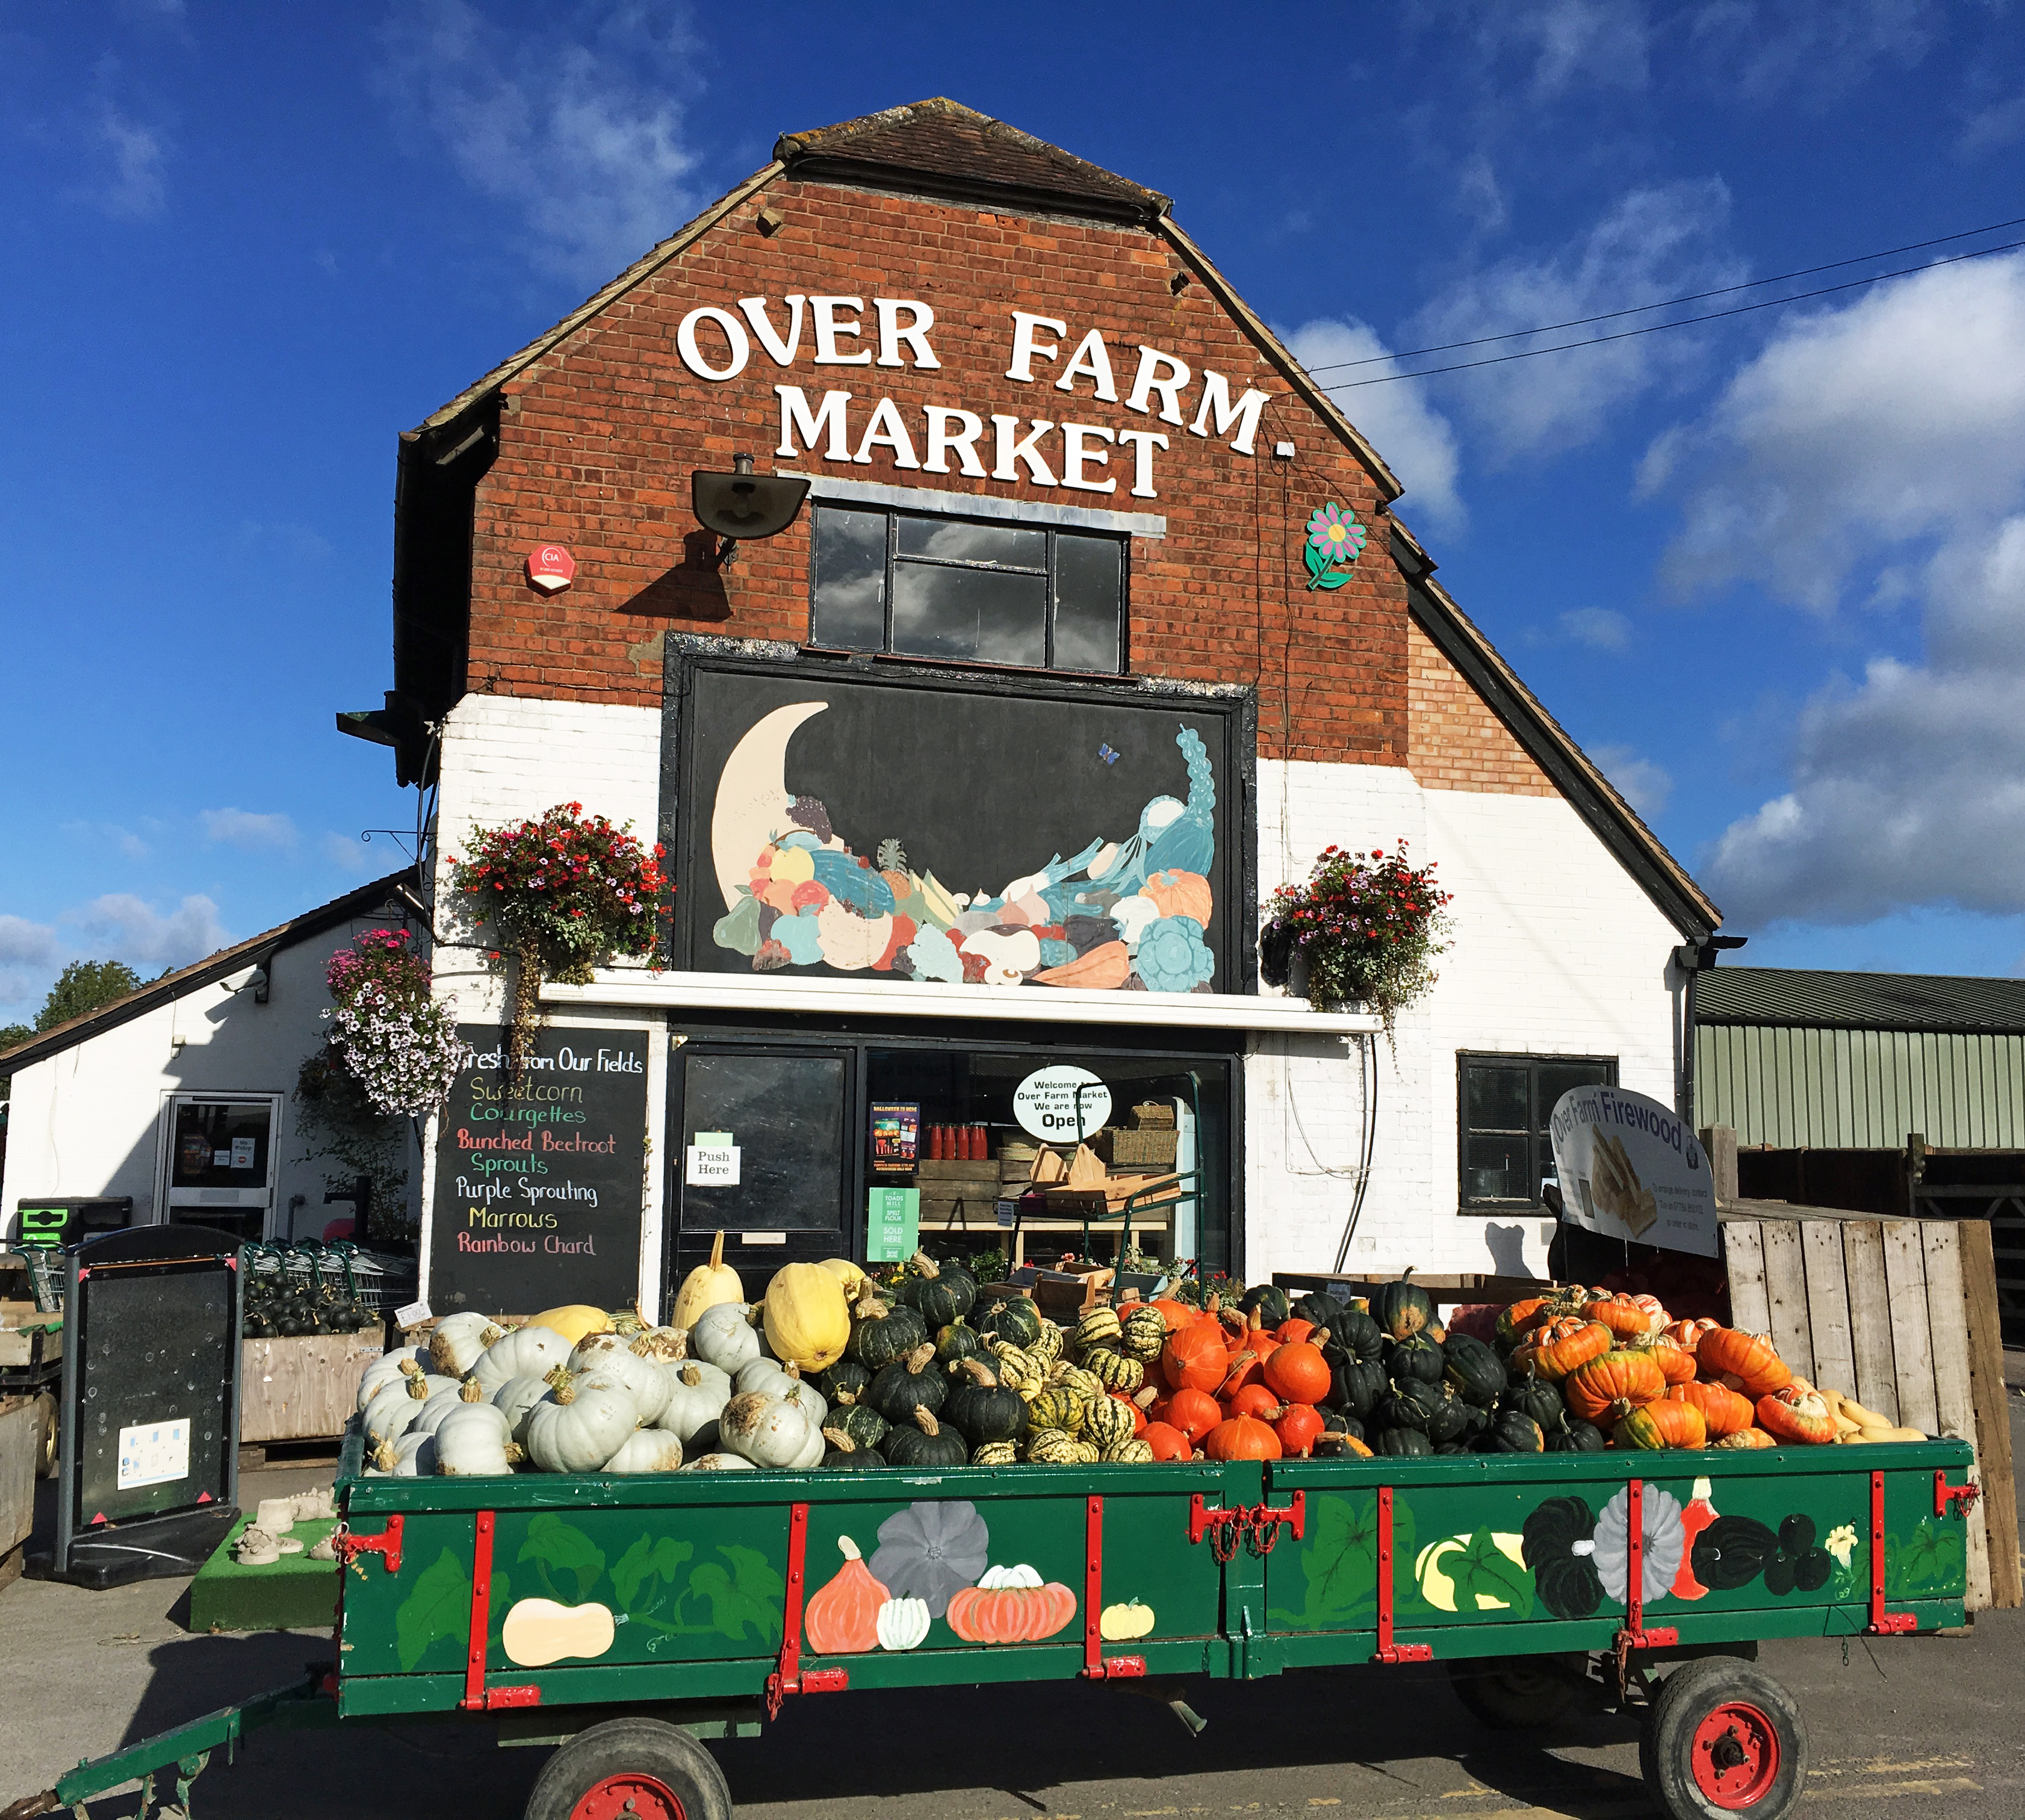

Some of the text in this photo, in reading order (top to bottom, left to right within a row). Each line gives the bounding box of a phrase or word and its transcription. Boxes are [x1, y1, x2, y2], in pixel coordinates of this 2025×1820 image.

[678, 295, 1270, 455] OVER FARM
[775, 385, 1170, 498] MARKET
[545, 553, 559, 562] CIA
[559, 1047, 592, 1071] Our
[597, 1049, 643, 1073] Fields
[470, 1076, 583, 1104] Sweetcorn
[470, 1103, 586, 1128] Courgettes
[1042, 1113, 1086, 1130] Open
[1554, 1091, 1682, 1155] Over Farm Firewood
[457, 1128, 616, 1154] Bunched Beetroot
[471, 1153, 548, 1177] Sprouts
[698, 1151, 730, 1162] Push
[698, 1164, 729, 1174] Here
[456, 1175, 598, 1208] Purple Sprouting
[469, 1207, 557, 1228] Marrows
[457, 1231, 596, 1255] Rainbow Chard
